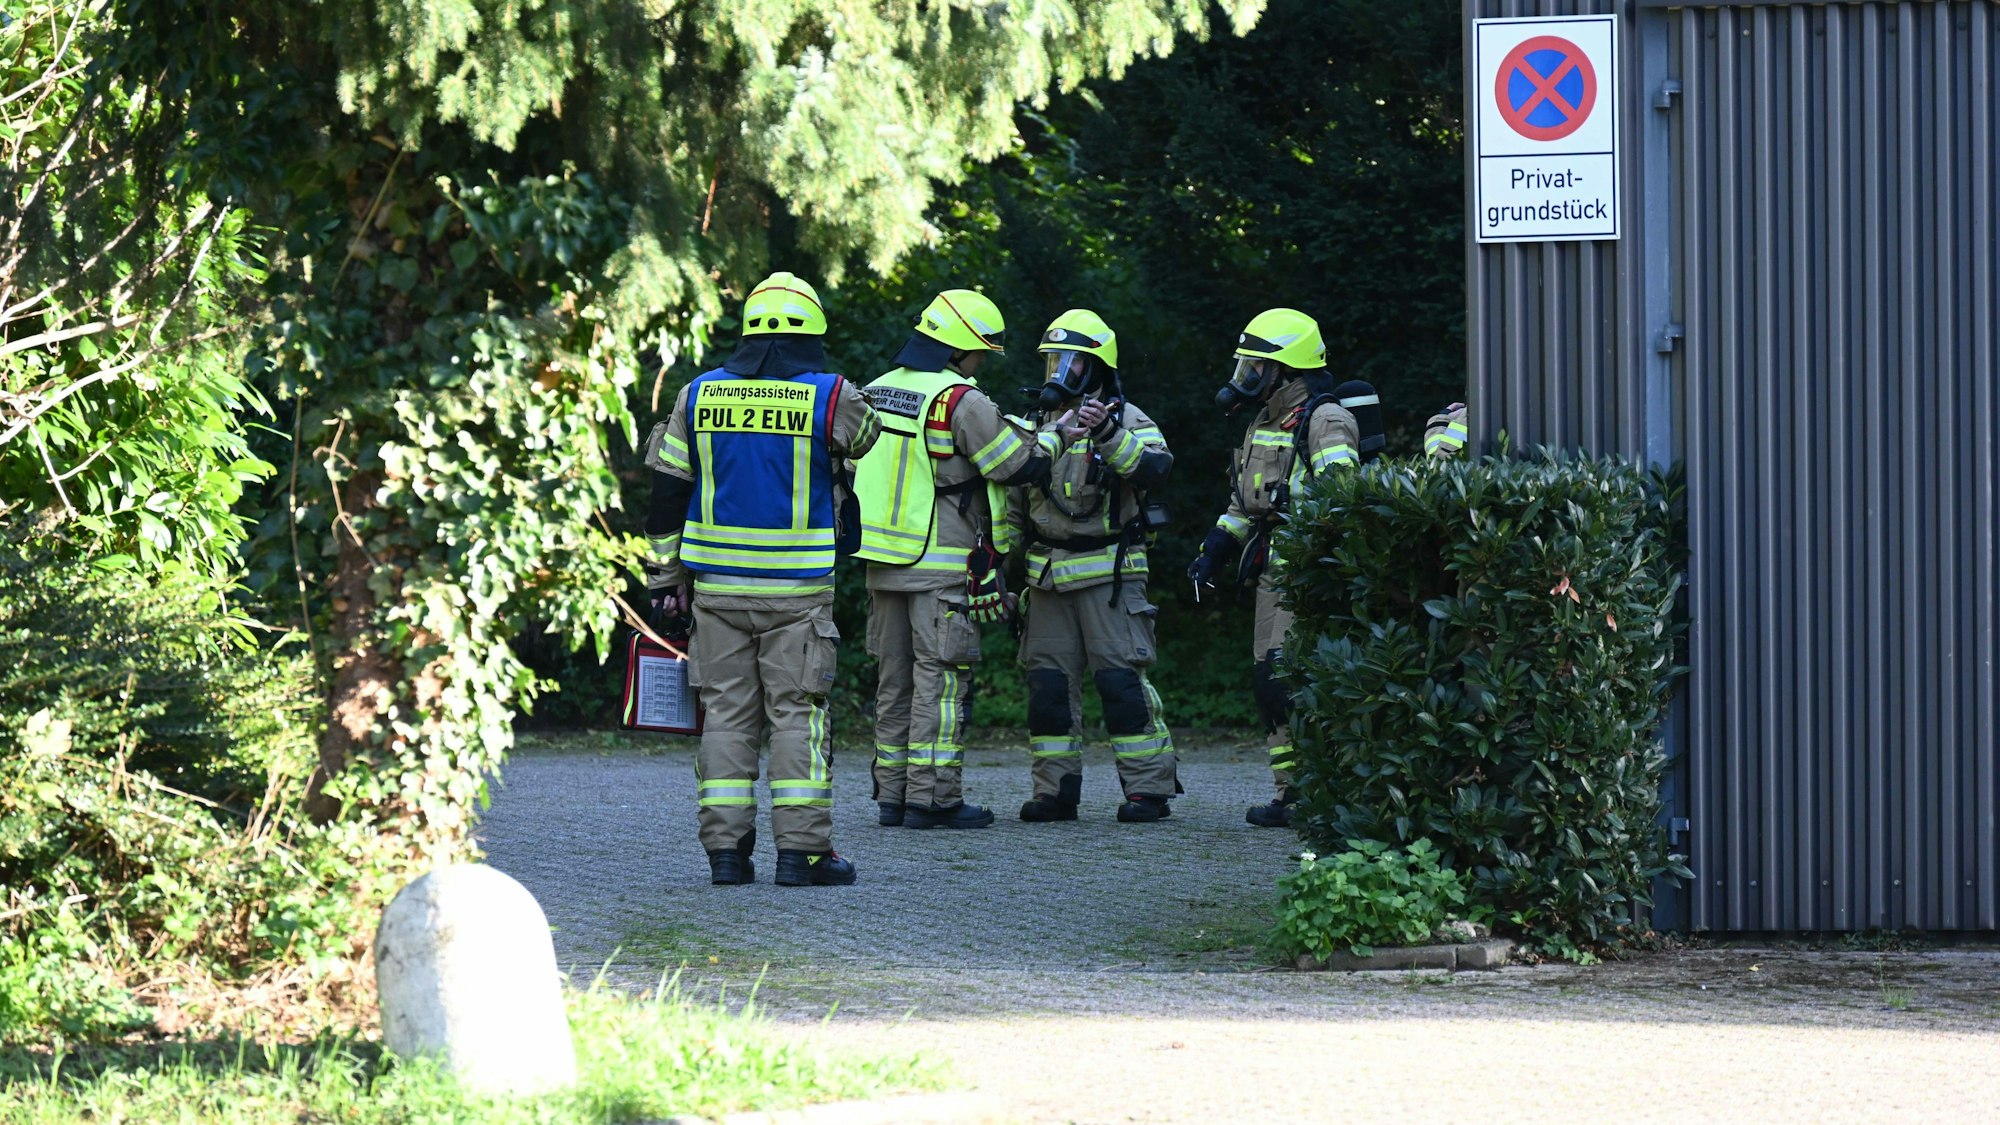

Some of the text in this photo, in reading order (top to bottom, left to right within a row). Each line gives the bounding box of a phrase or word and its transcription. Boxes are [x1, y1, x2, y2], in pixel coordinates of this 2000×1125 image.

[1511, 168, 1583, 189] Privat-
[1488, 198, 1608, 227] grundstück
[702, 385, 810, 401] Führungsassistent
[889, 399, 918, 412] PULHEIM
[698, 408, 809, 431] PUL 2 ELW
